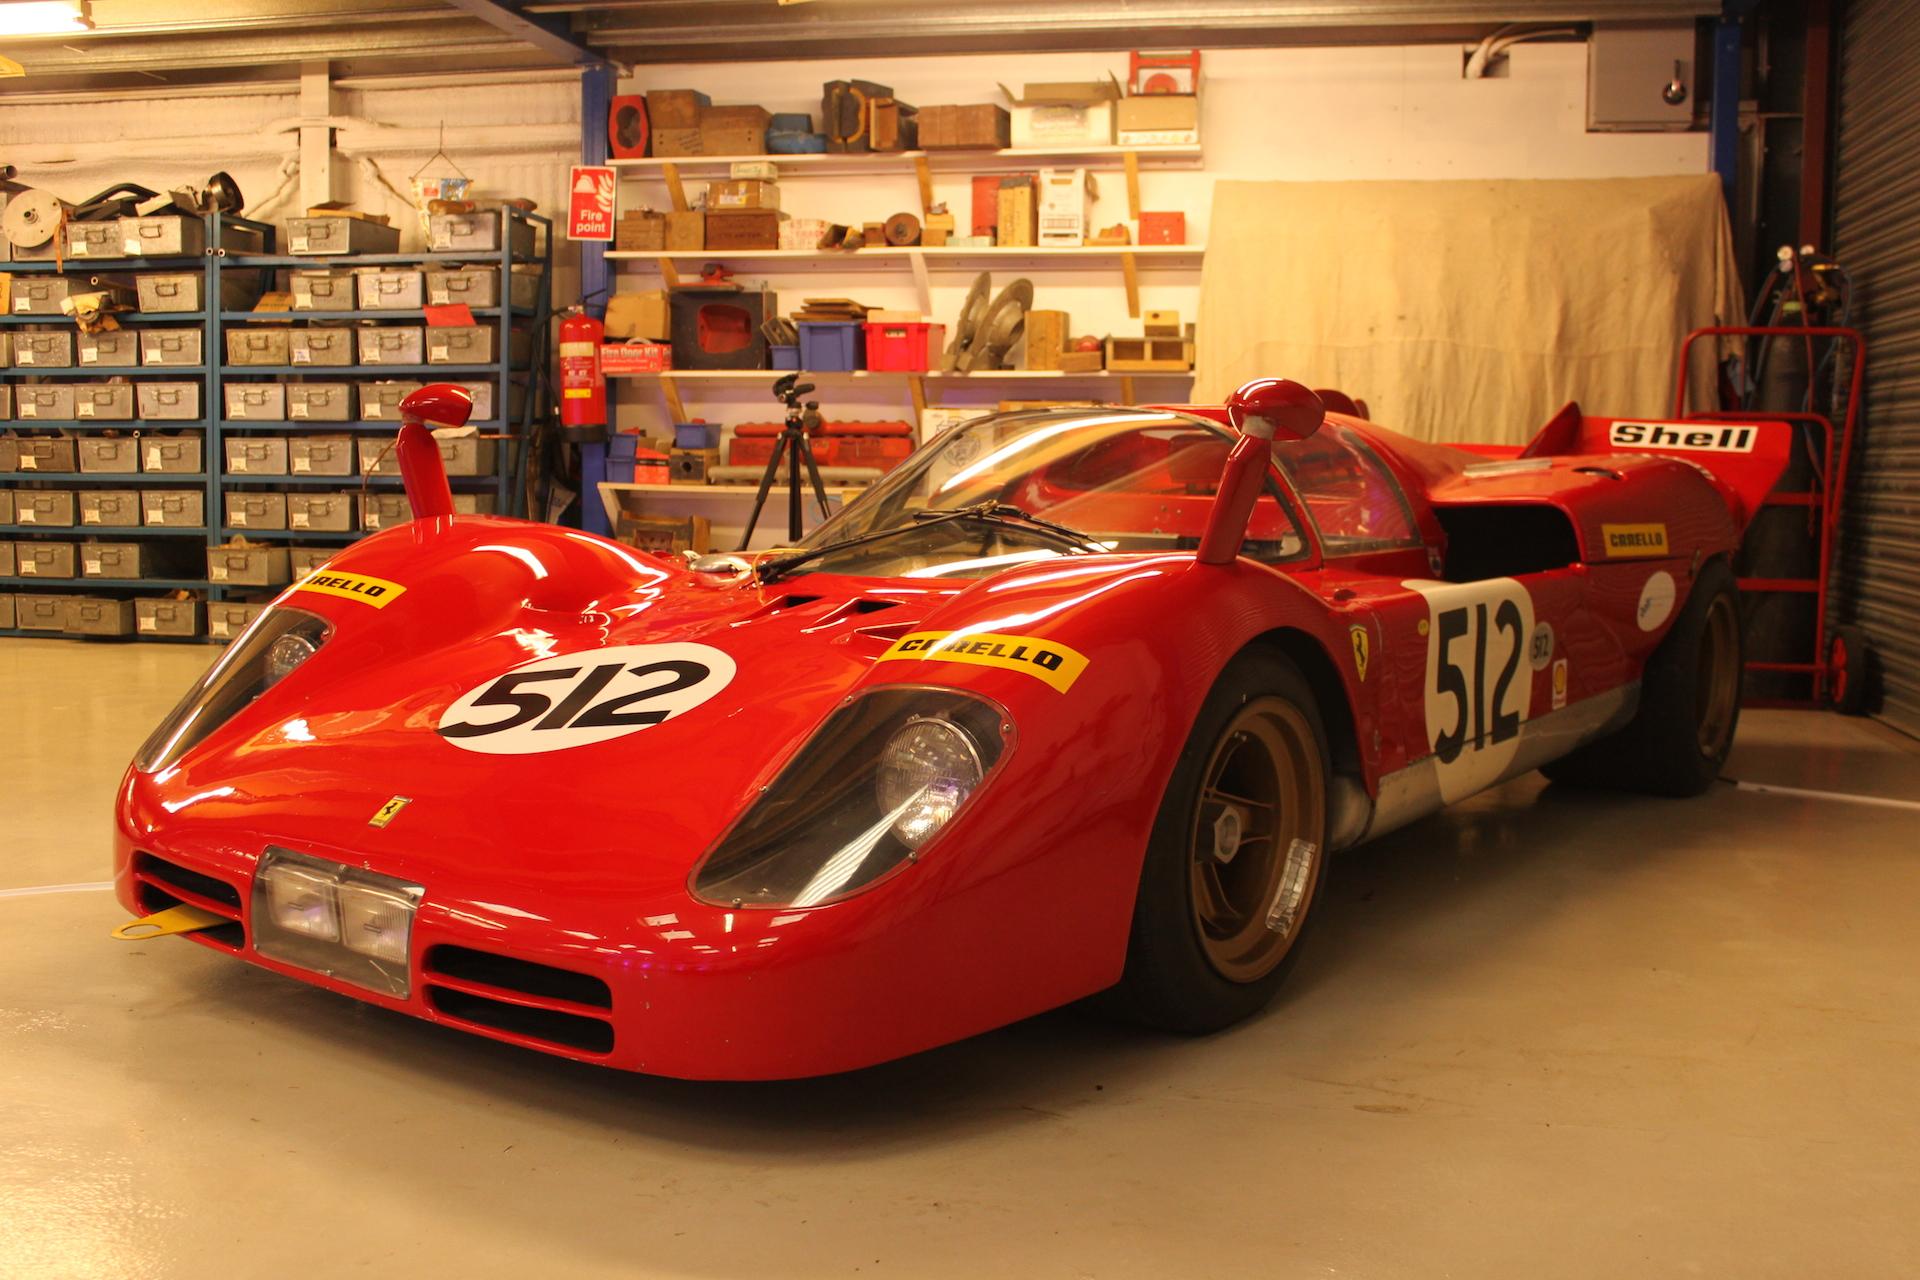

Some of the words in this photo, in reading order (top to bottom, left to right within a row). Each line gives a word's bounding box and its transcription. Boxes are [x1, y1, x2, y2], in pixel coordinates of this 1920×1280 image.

[576, 221, 606, 235] point
[580, 209, 603, 222] Fire
[1613, 424, 1752, 450] Shell
[1533, 633, 1548, 660] 512
[1434, 598, 1524, 764] 512
[437, 659, 711, 738] 512
